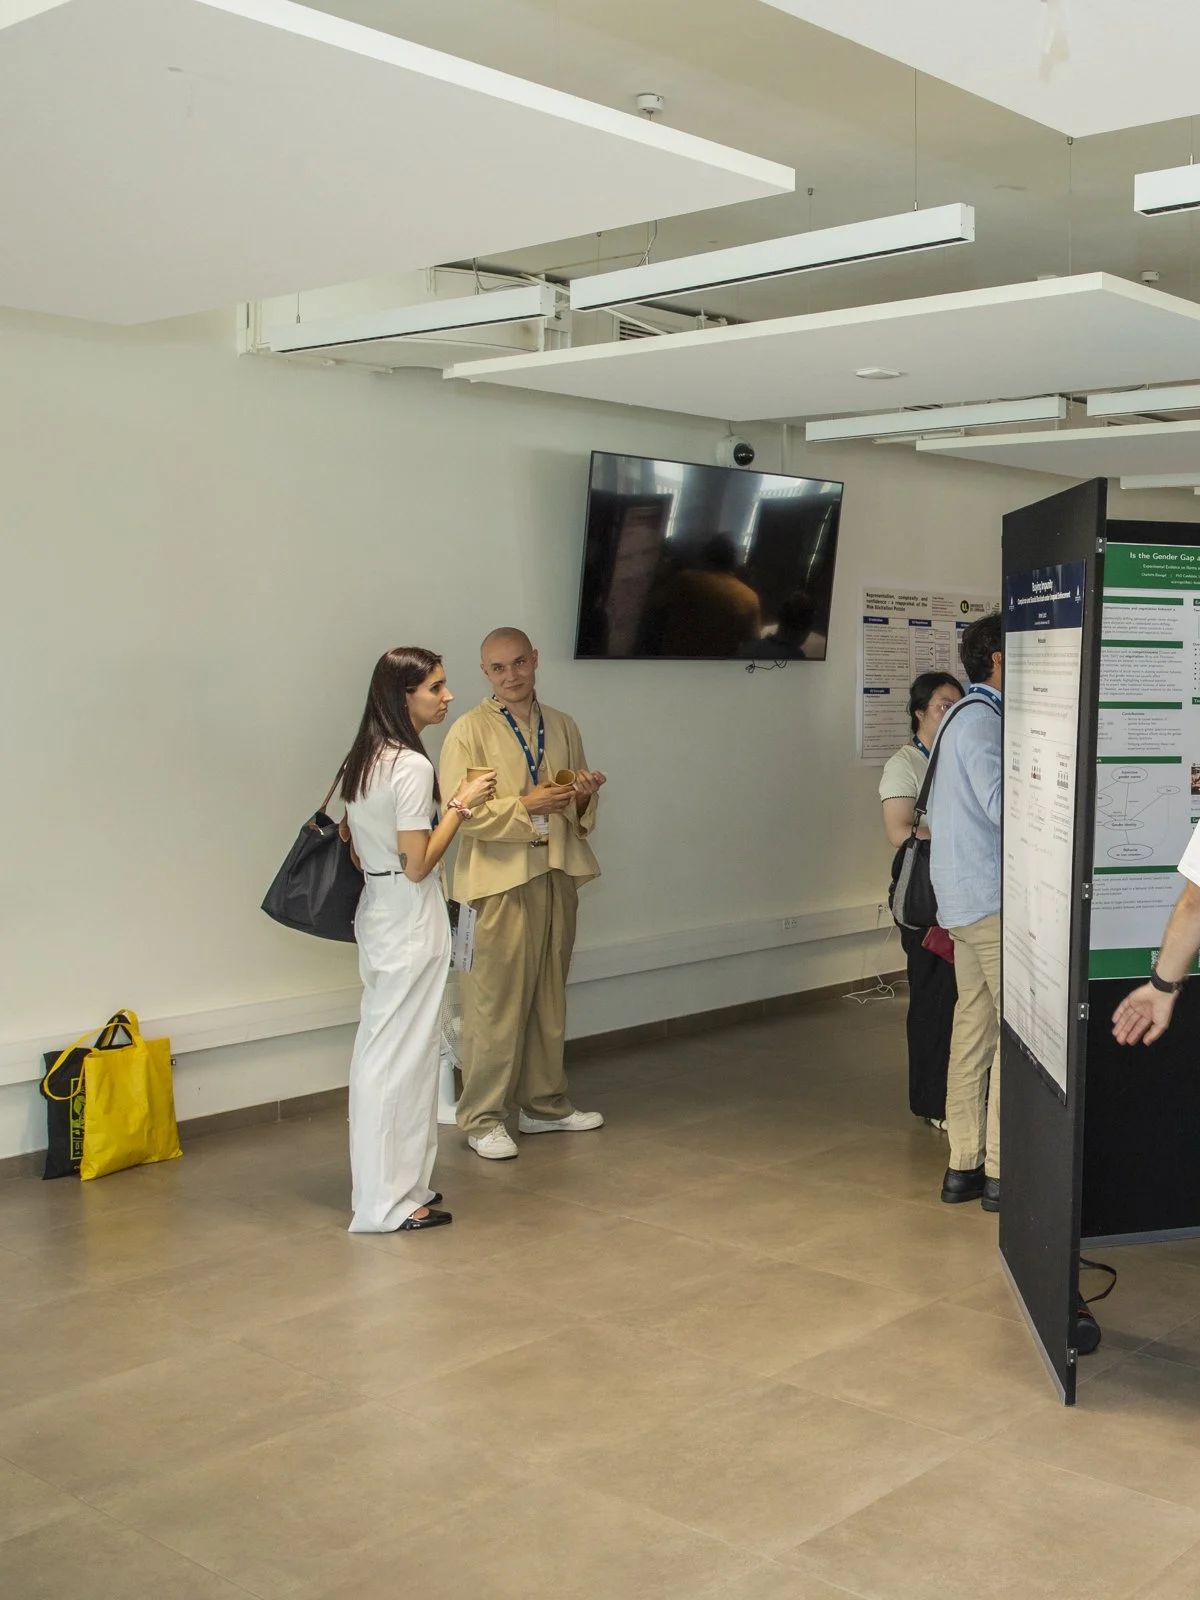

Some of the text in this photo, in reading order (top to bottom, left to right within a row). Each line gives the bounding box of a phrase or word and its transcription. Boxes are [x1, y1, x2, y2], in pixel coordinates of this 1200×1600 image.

[1138, 552, 1150, 560] the
[1152, 553, 1178, 561] Gender
[1180, 554, 1195, 562] Gap
